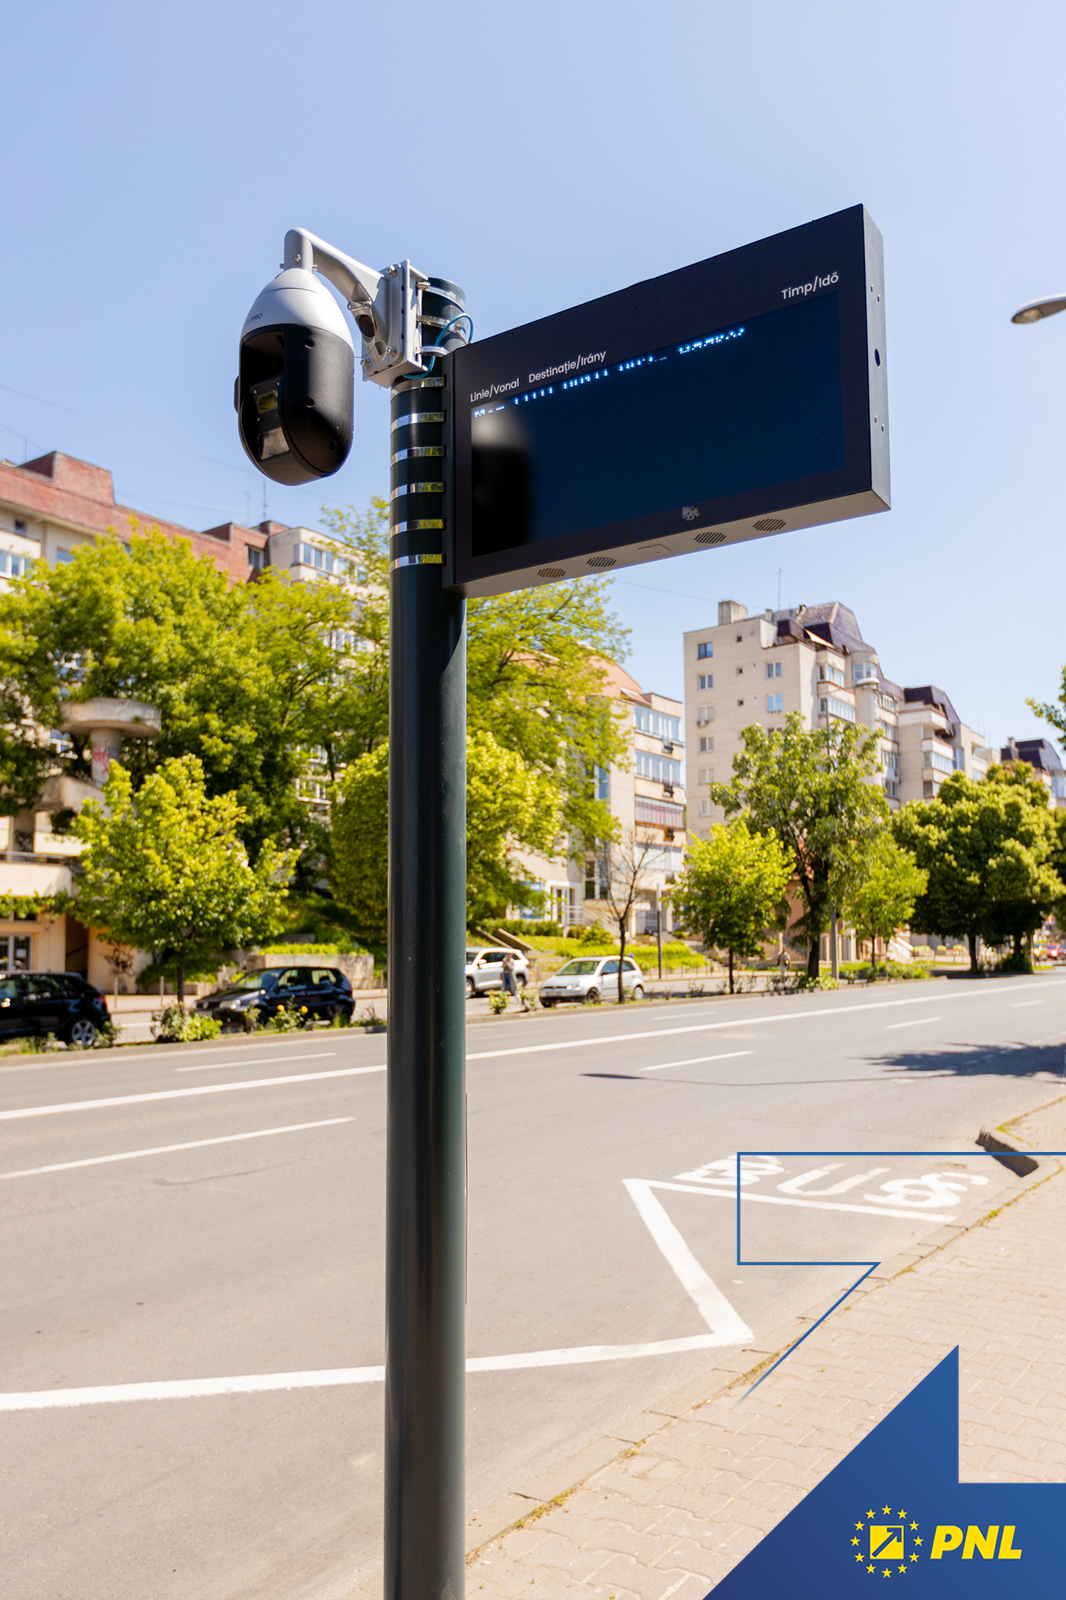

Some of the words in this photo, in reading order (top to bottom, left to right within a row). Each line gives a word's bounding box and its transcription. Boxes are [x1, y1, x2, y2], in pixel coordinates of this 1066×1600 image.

[781, 271, 839, 300] Timp/Idő
[470, 377, 520, 403] Linie/Vonal
[672, 1153, 989, 1207] BUS
